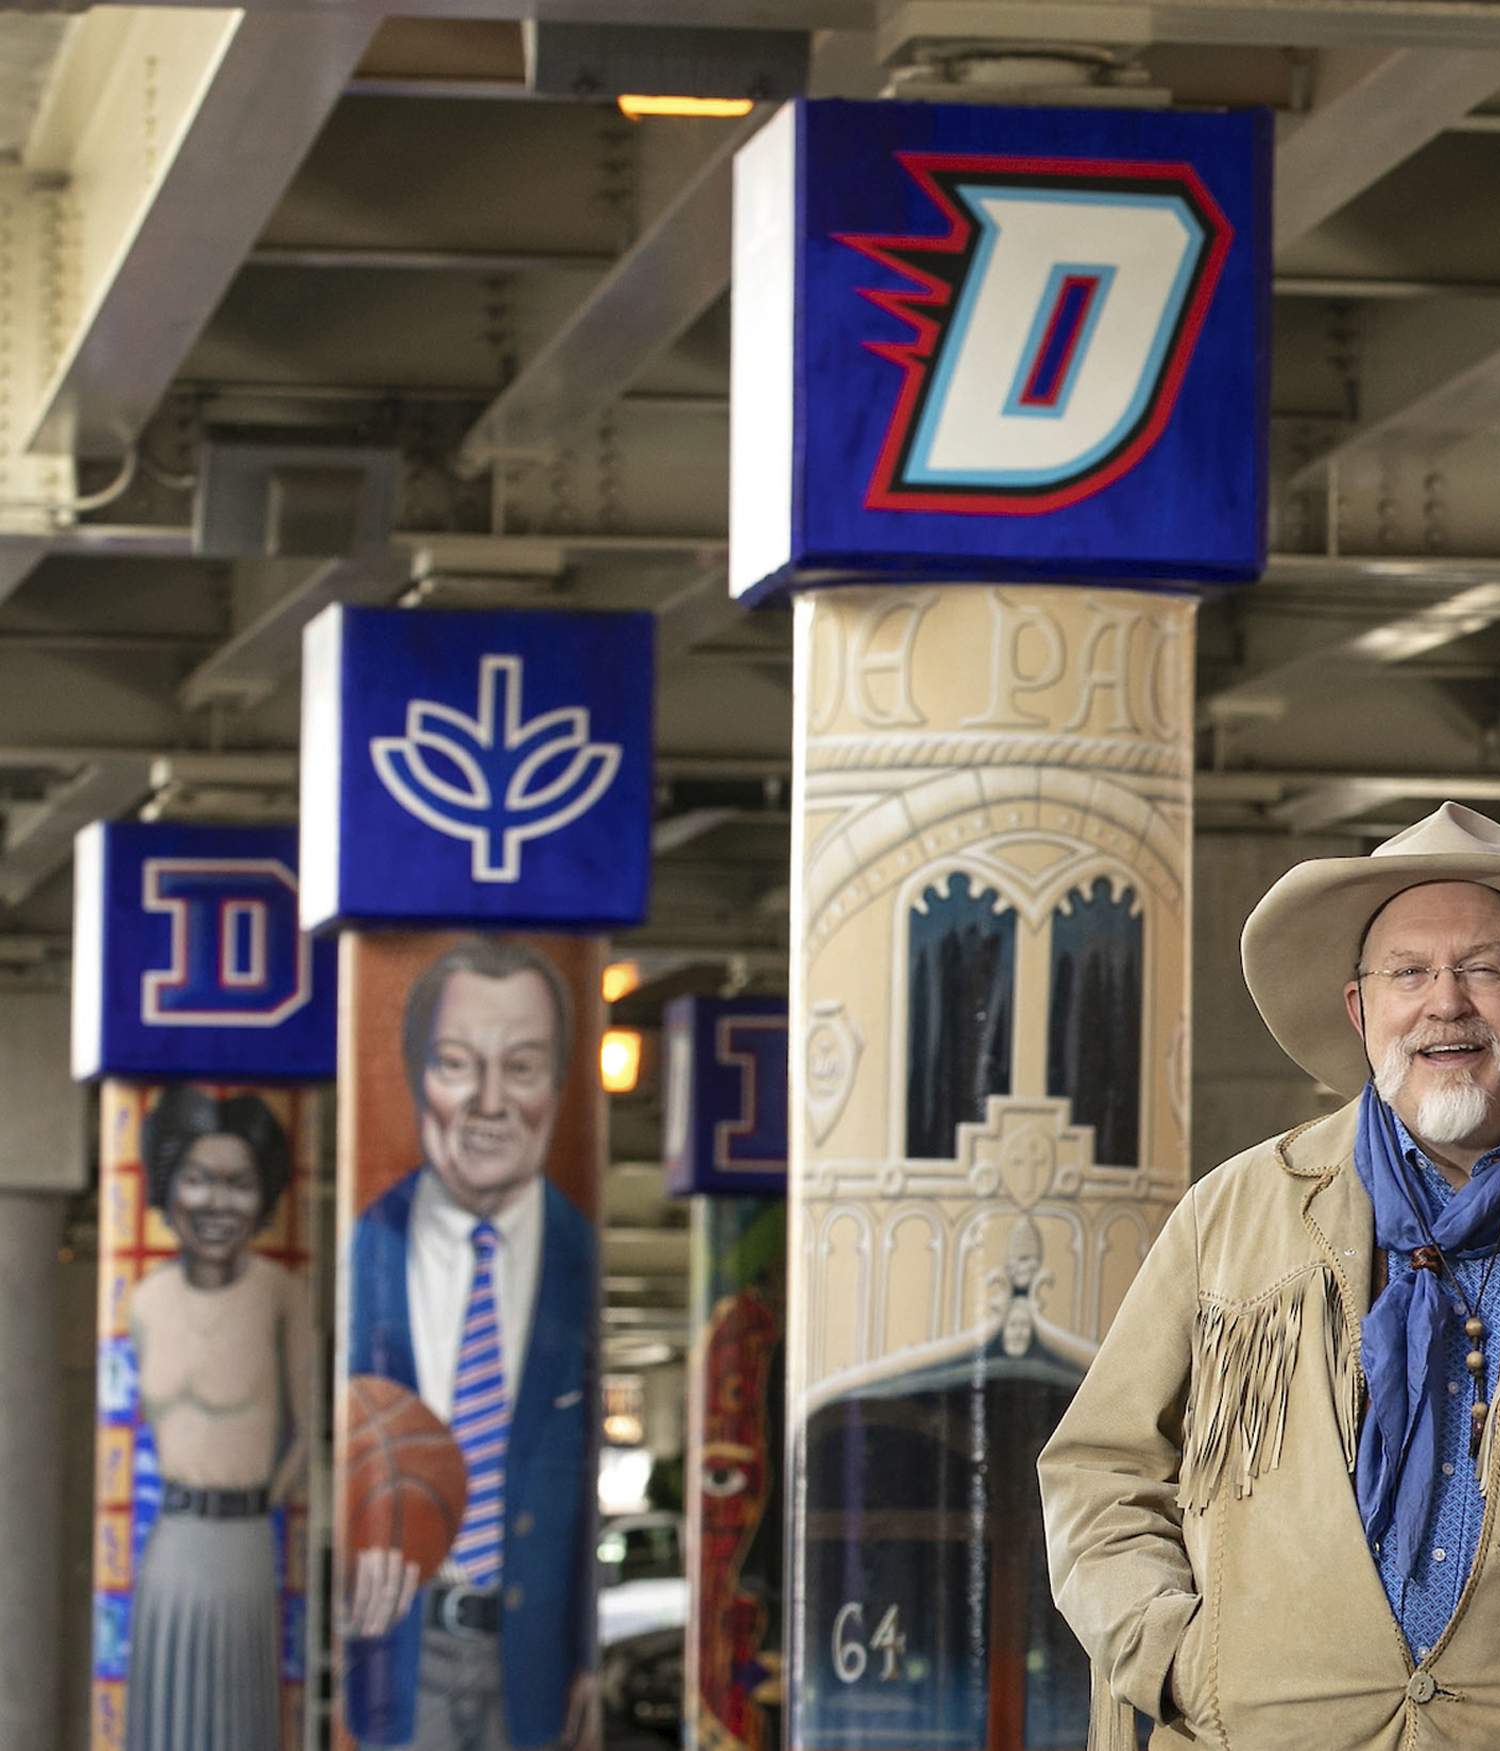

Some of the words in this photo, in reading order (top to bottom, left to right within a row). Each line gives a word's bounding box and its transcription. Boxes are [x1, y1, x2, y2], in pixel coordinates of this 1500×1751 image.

[864, 153, 1234, 516] D
[142, 858, 312, 1026] D
[831, 1602, 907, 1683] 64
